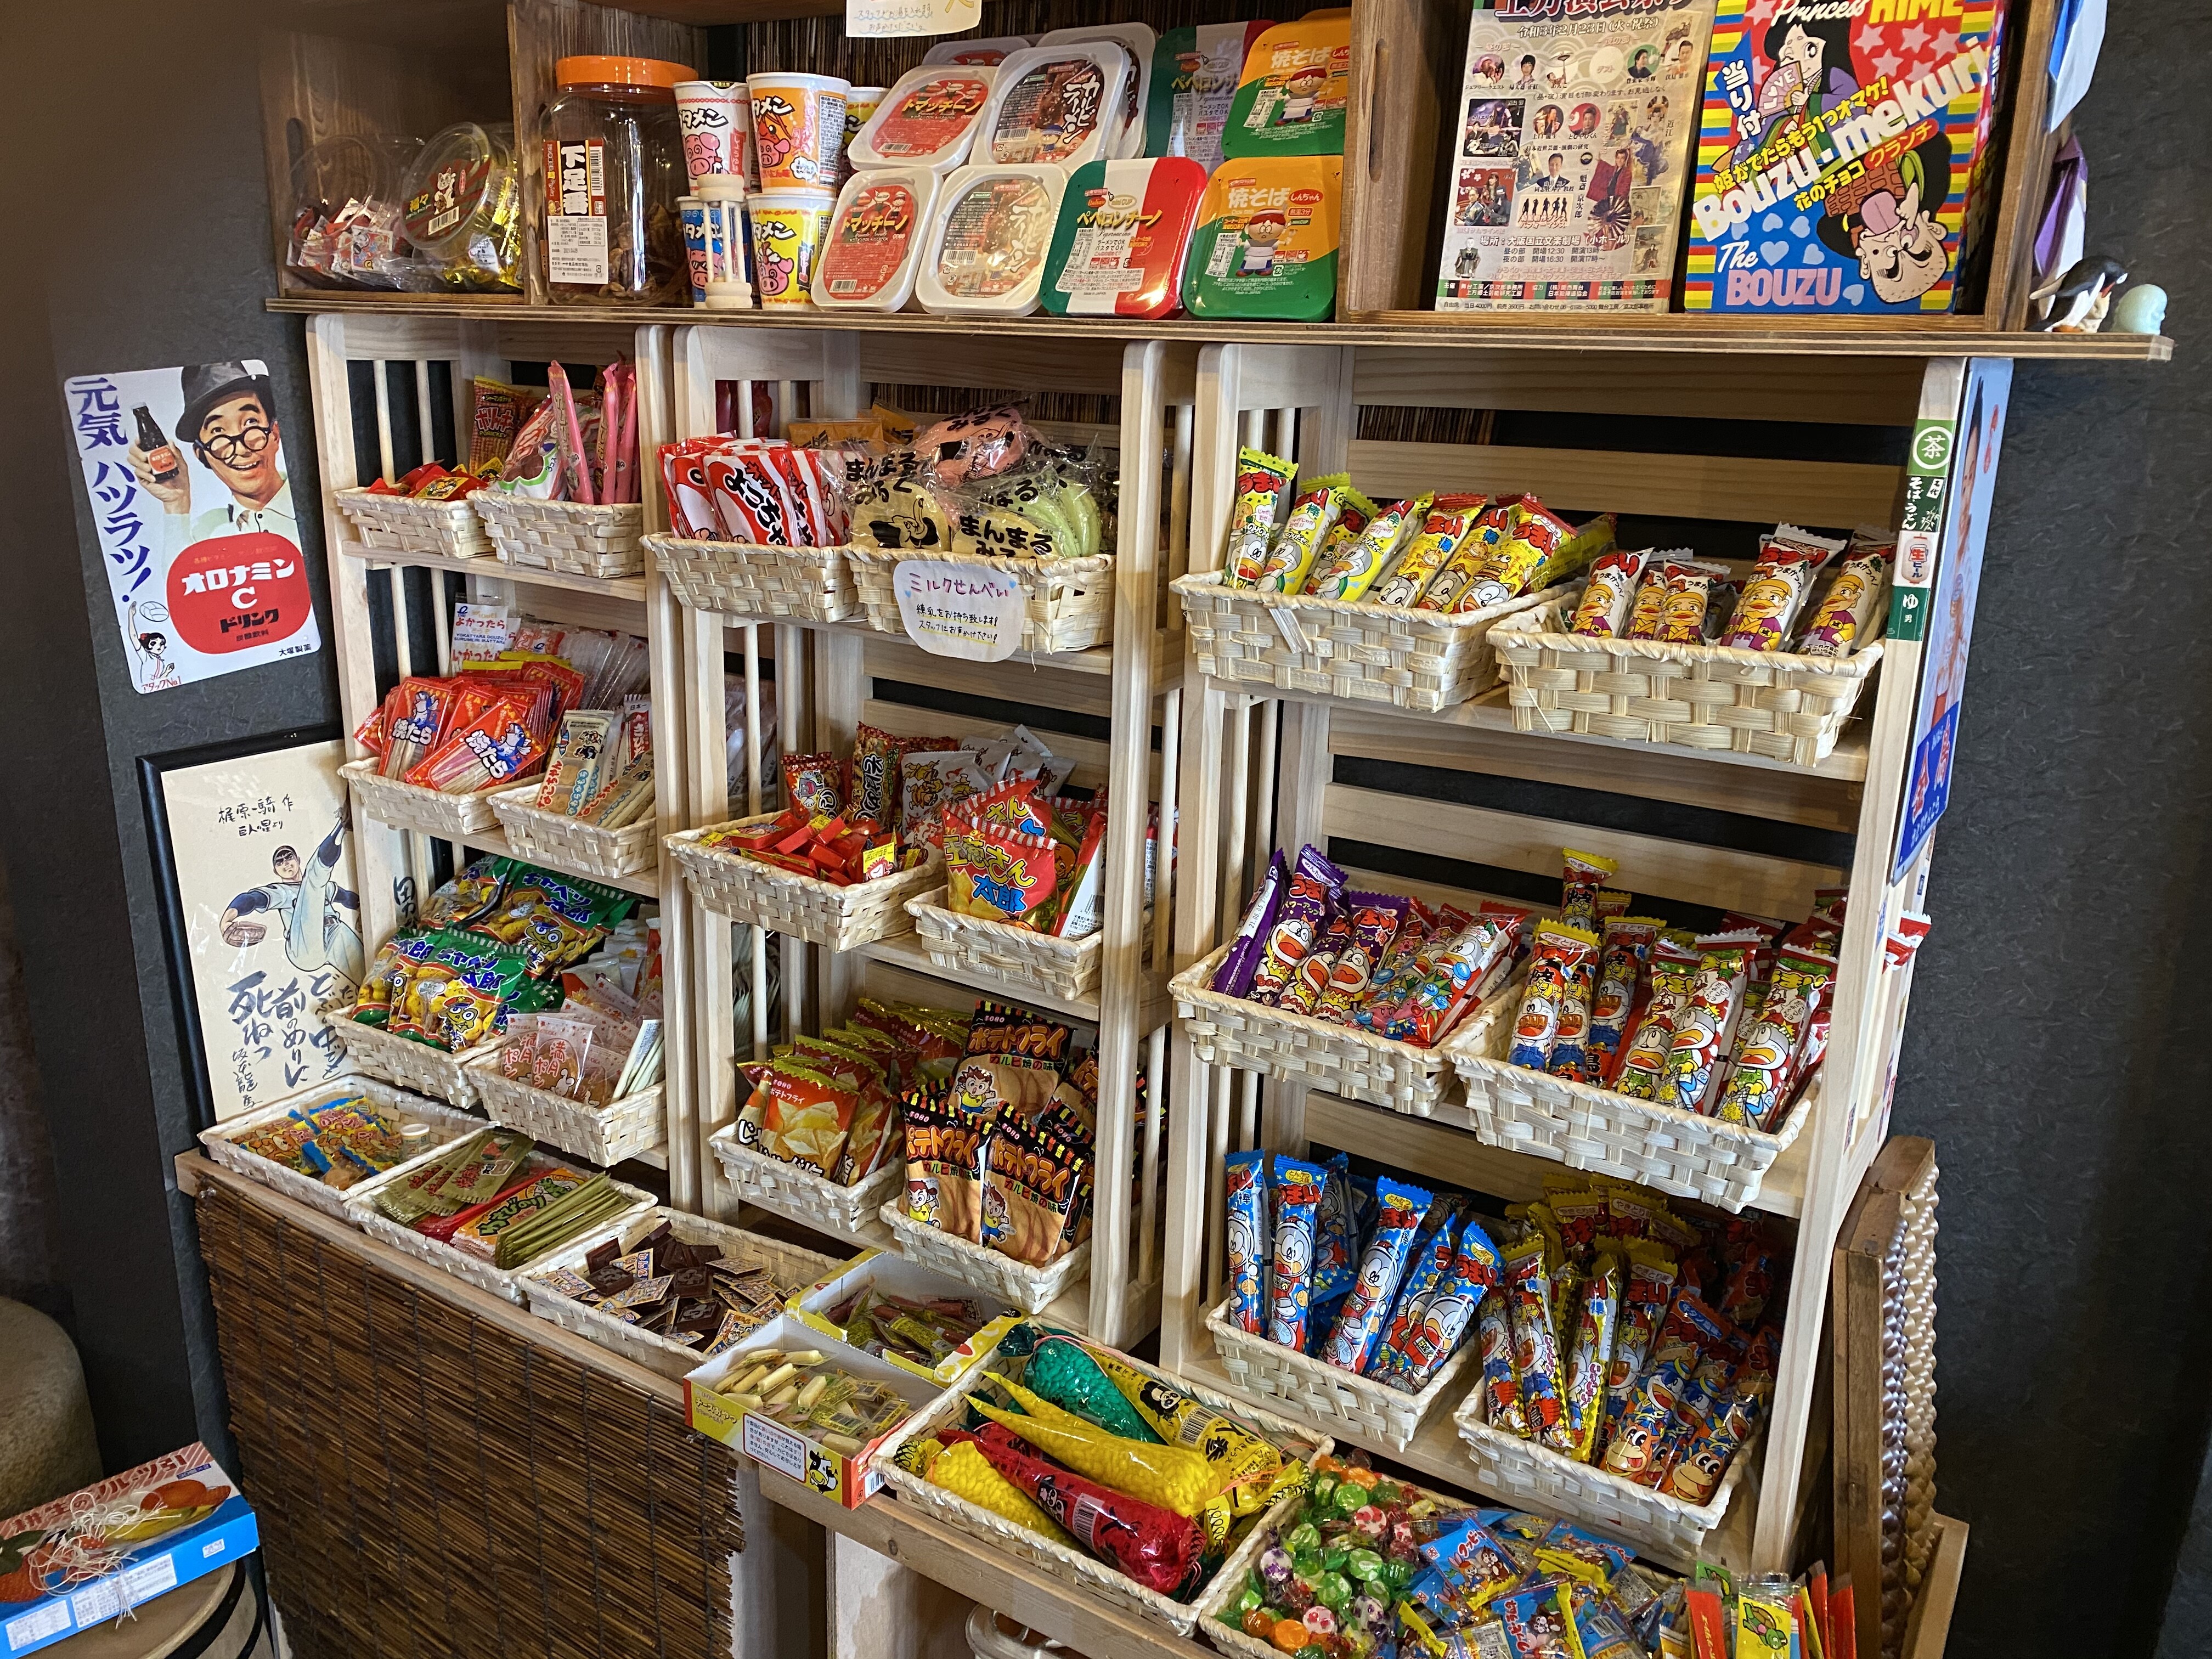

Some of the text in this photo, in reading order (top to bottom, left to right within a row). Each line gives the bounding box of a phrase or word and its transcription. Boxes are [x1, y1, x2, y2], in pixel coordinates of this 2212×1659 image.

[1271, 47, 1334, 69] 焼そば
[1171, 73, 1239, 94] ペペロンチ
[752, 95, 795, 115] タメン
[901, 98, 982, 114] トマッチーノ
[1722, 60, 1762, 142] 当り付
[679, 108, 729, 130] タメン
[561, 145, 589, 215] 下足番
[1228, 187, 1321, 208] 焼そば しんちゃん
[840, 215, 909, 233] トマッチーノ
[1077, 209, 1163, 230] ペペロンチーノ
[752, 221, 797, 241] タメン
[1718, 241, 1843, 307] The BOUZU
[70, 376, 129, 451] 元気
[1921, 435, 1945, 459] 茶
[182, 558, 295, 596] オロナミン
[909, 572, 1009, 598] ミルクせんべい
[231, 586, 258, 609] C
[1902, 593, 1919, 609] ゆ
[219, 608, 280, 633] ドリンク
[455, 617, 505, 629] よかったら
[1904, 614, 1912, 623] 男
[279, 643, 312, 656] 大塚製薬
[392, 718, 433, 745] 焼たら
[465, 729, 509, 779] 焼たら
[522, 872, 594, 907] キャベツ
[972, 874, 1028, 913] 太郎
[460, 969, 507, 991] 太郎
[984, 1015, 1006, 1023] TOHO
[967, 1024, 1068, 1060] ポテトフライ
[773, 1079, 792, 1090] TOHO
[909, 1111, 929, 1122] TOHO
[1002, 1122, 1020, 1140] TOHO
[990, 1135, 1071, 1203] ポテトフライ
